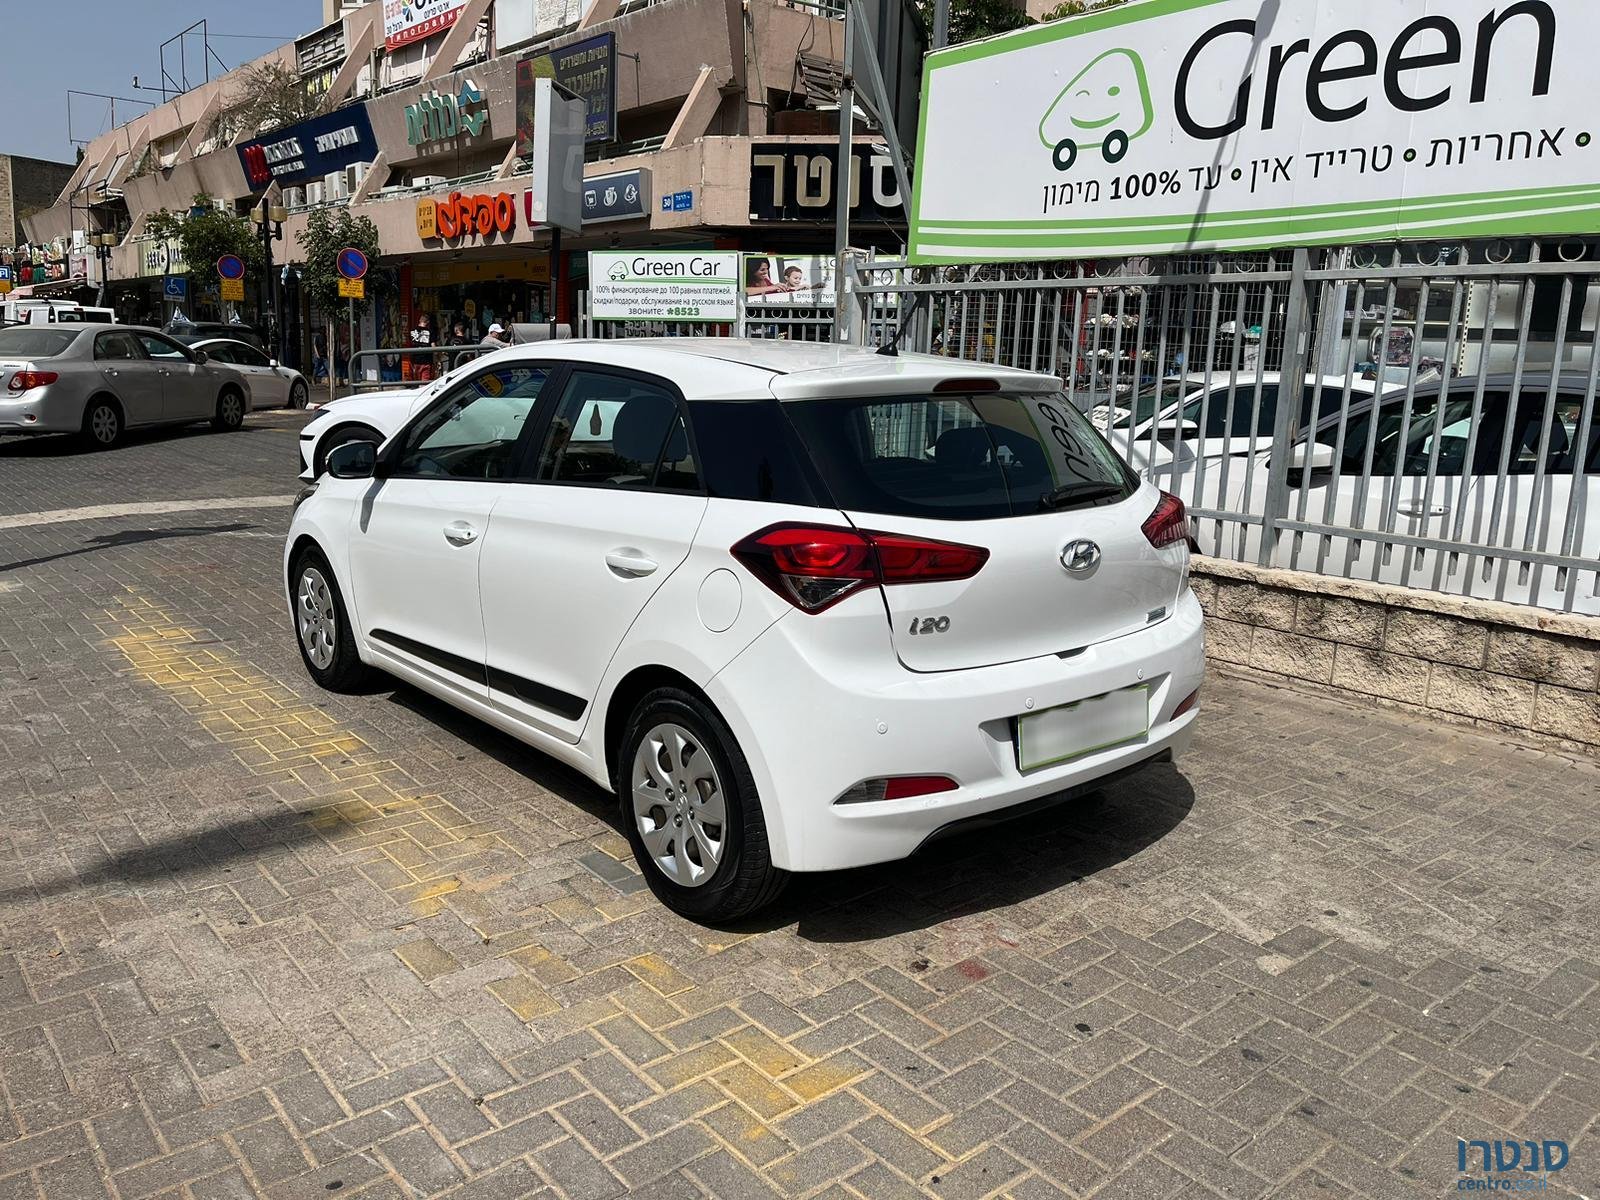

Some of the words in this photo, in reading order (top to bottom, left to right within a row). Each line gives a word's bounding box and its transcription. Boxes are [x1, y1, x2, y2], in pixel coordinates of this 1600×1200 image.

[1174, 0, 1556, 140] Green
[1306, 143, 1394, 179] טרייד
[1425, 126, 1566, 168] אחריות
[1109, 171, 1181, 201] 100%
[1188, 164, 1223, 192] עד
[1249, 155, 1293, 193] אין
[1042, 176, 1100, 214] מימון
[632, 257, 685, 276] Green
[690, 257, 720, 276] Car
[595, 286, 610, 294] 100%
[611, 286, 659, 295] финансирование
[669, 286, 679, 294] 100
[680, 287, 701, 295] равных
[641, 297, 682, 306] обслуживание
[909, 615, 951, 636] i20
